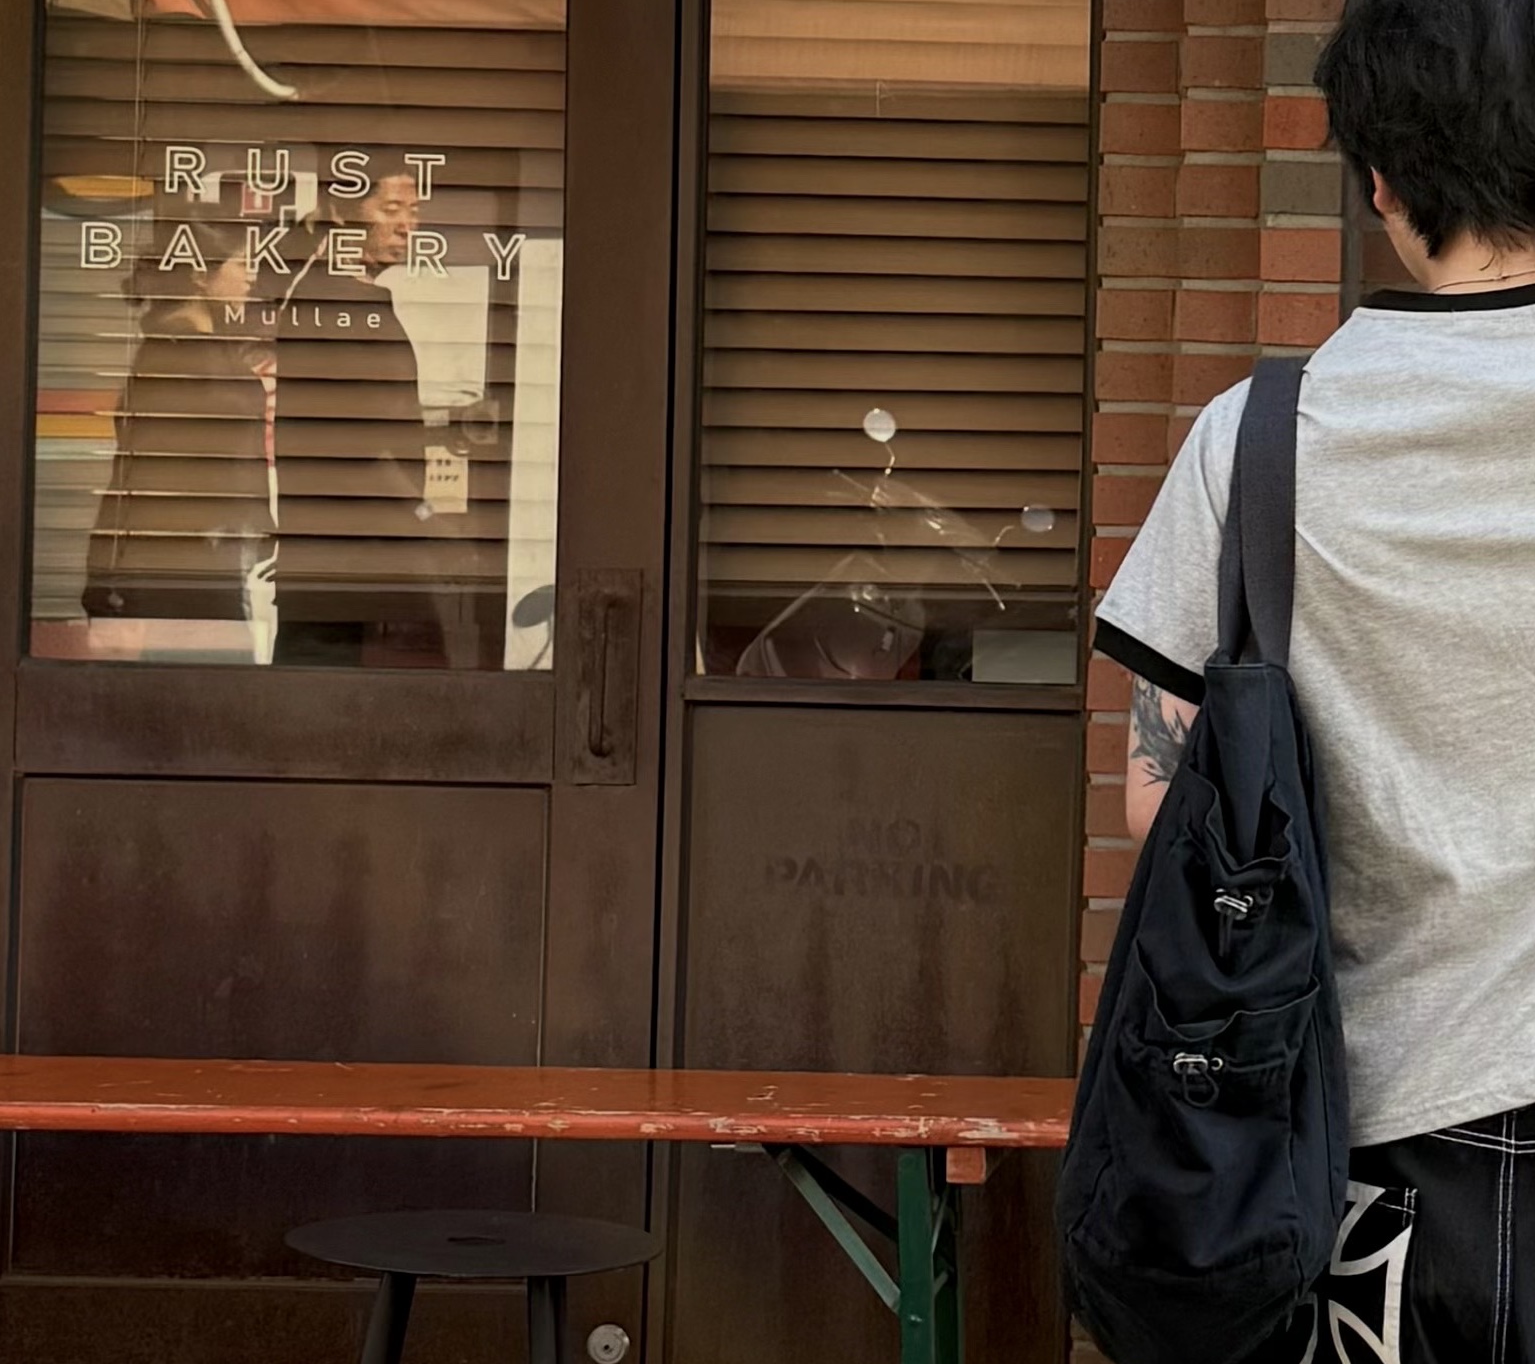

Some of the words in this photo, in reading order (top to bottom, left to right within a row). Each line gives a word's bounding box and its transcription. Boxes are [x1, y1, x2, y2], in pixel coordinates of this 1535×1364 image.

[164, 146, 447, 201] RUST
[80, 221, 526, 282] BAKERY
[224, 304, 381, 329] Mullae
